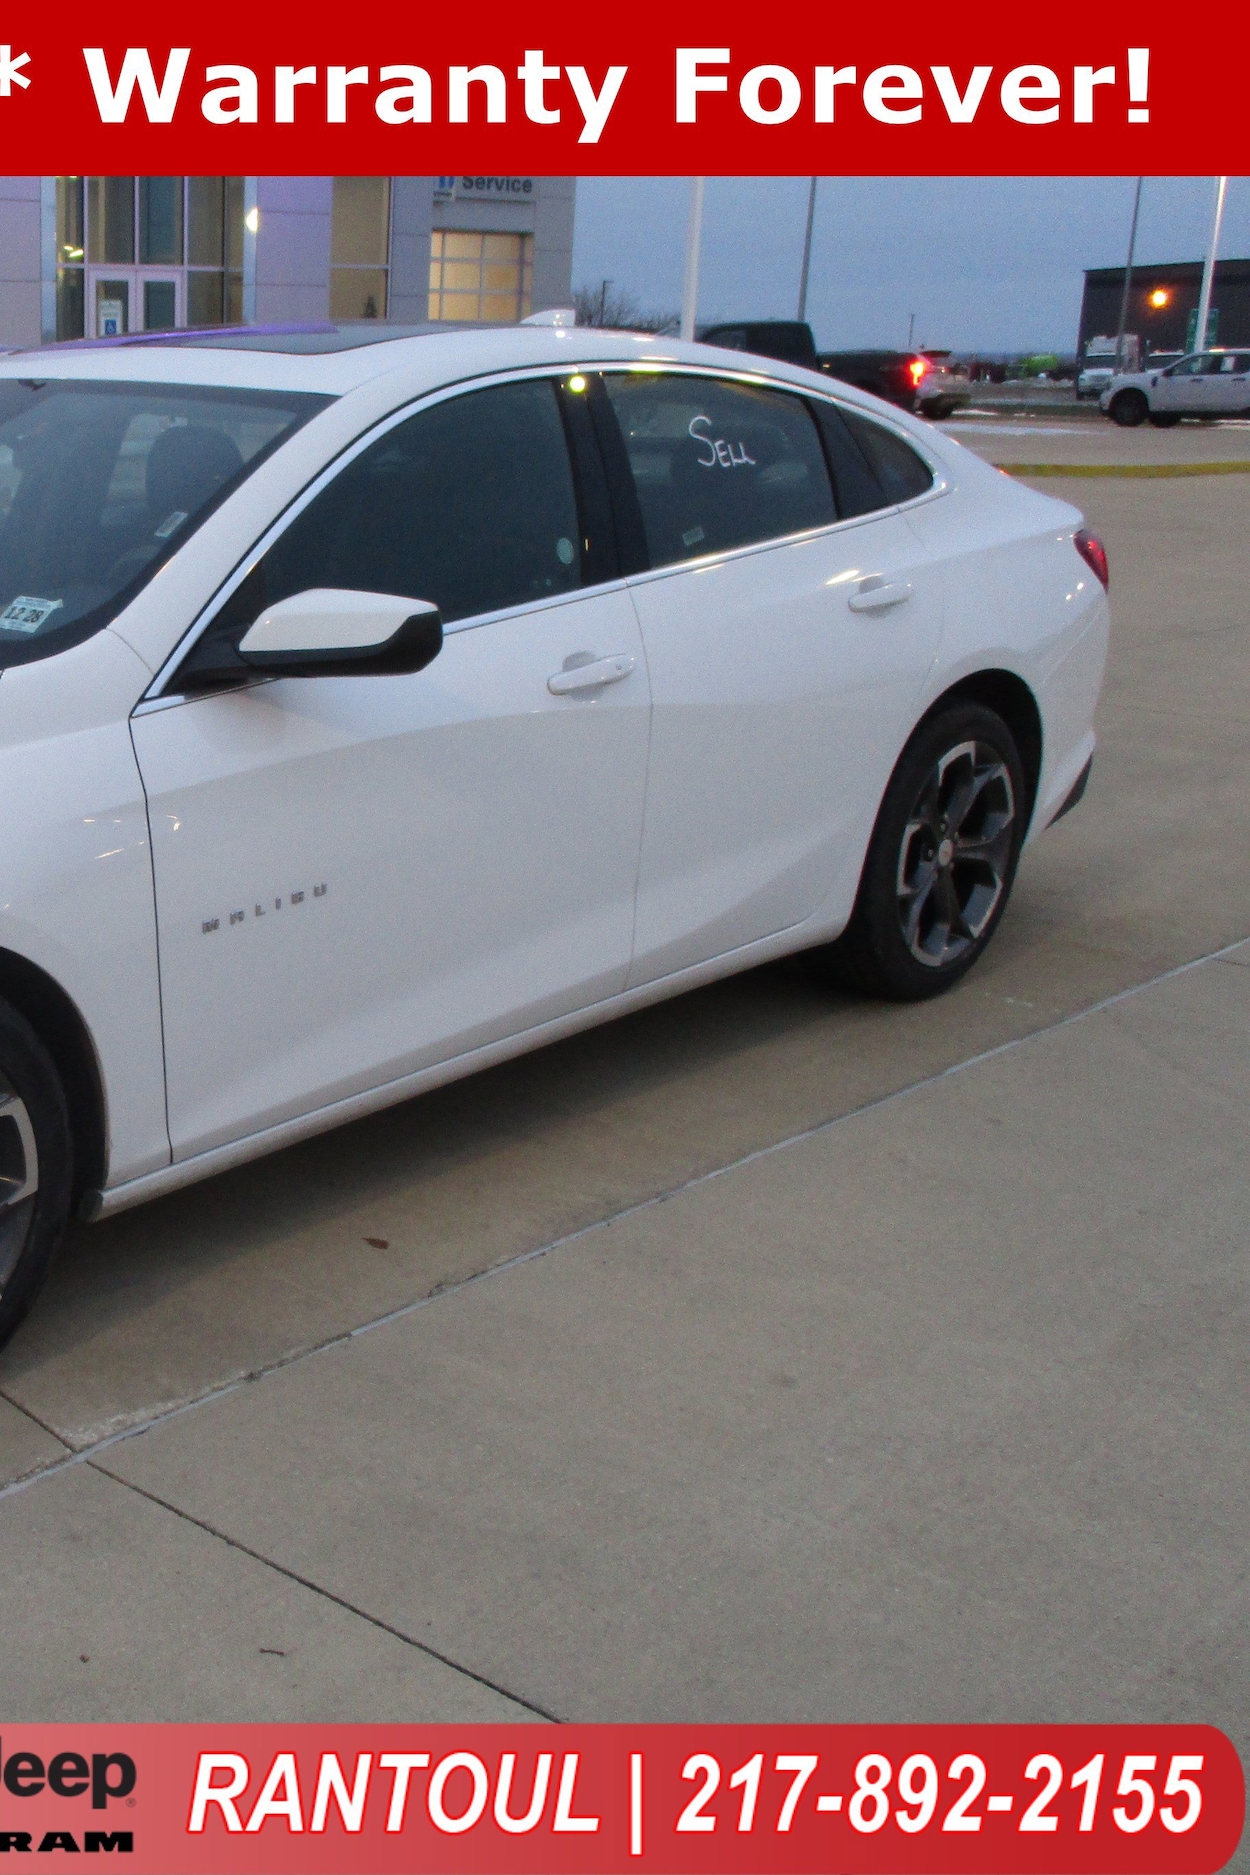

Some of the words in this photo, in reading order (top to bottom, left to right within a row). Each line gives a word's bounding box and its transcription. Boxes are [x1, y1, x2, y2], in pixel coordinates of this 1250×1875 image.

[461, 176, 533, 194] Service
[3, 605, 26, 620] 12
[201, 882, 328, 935] MALIBU
